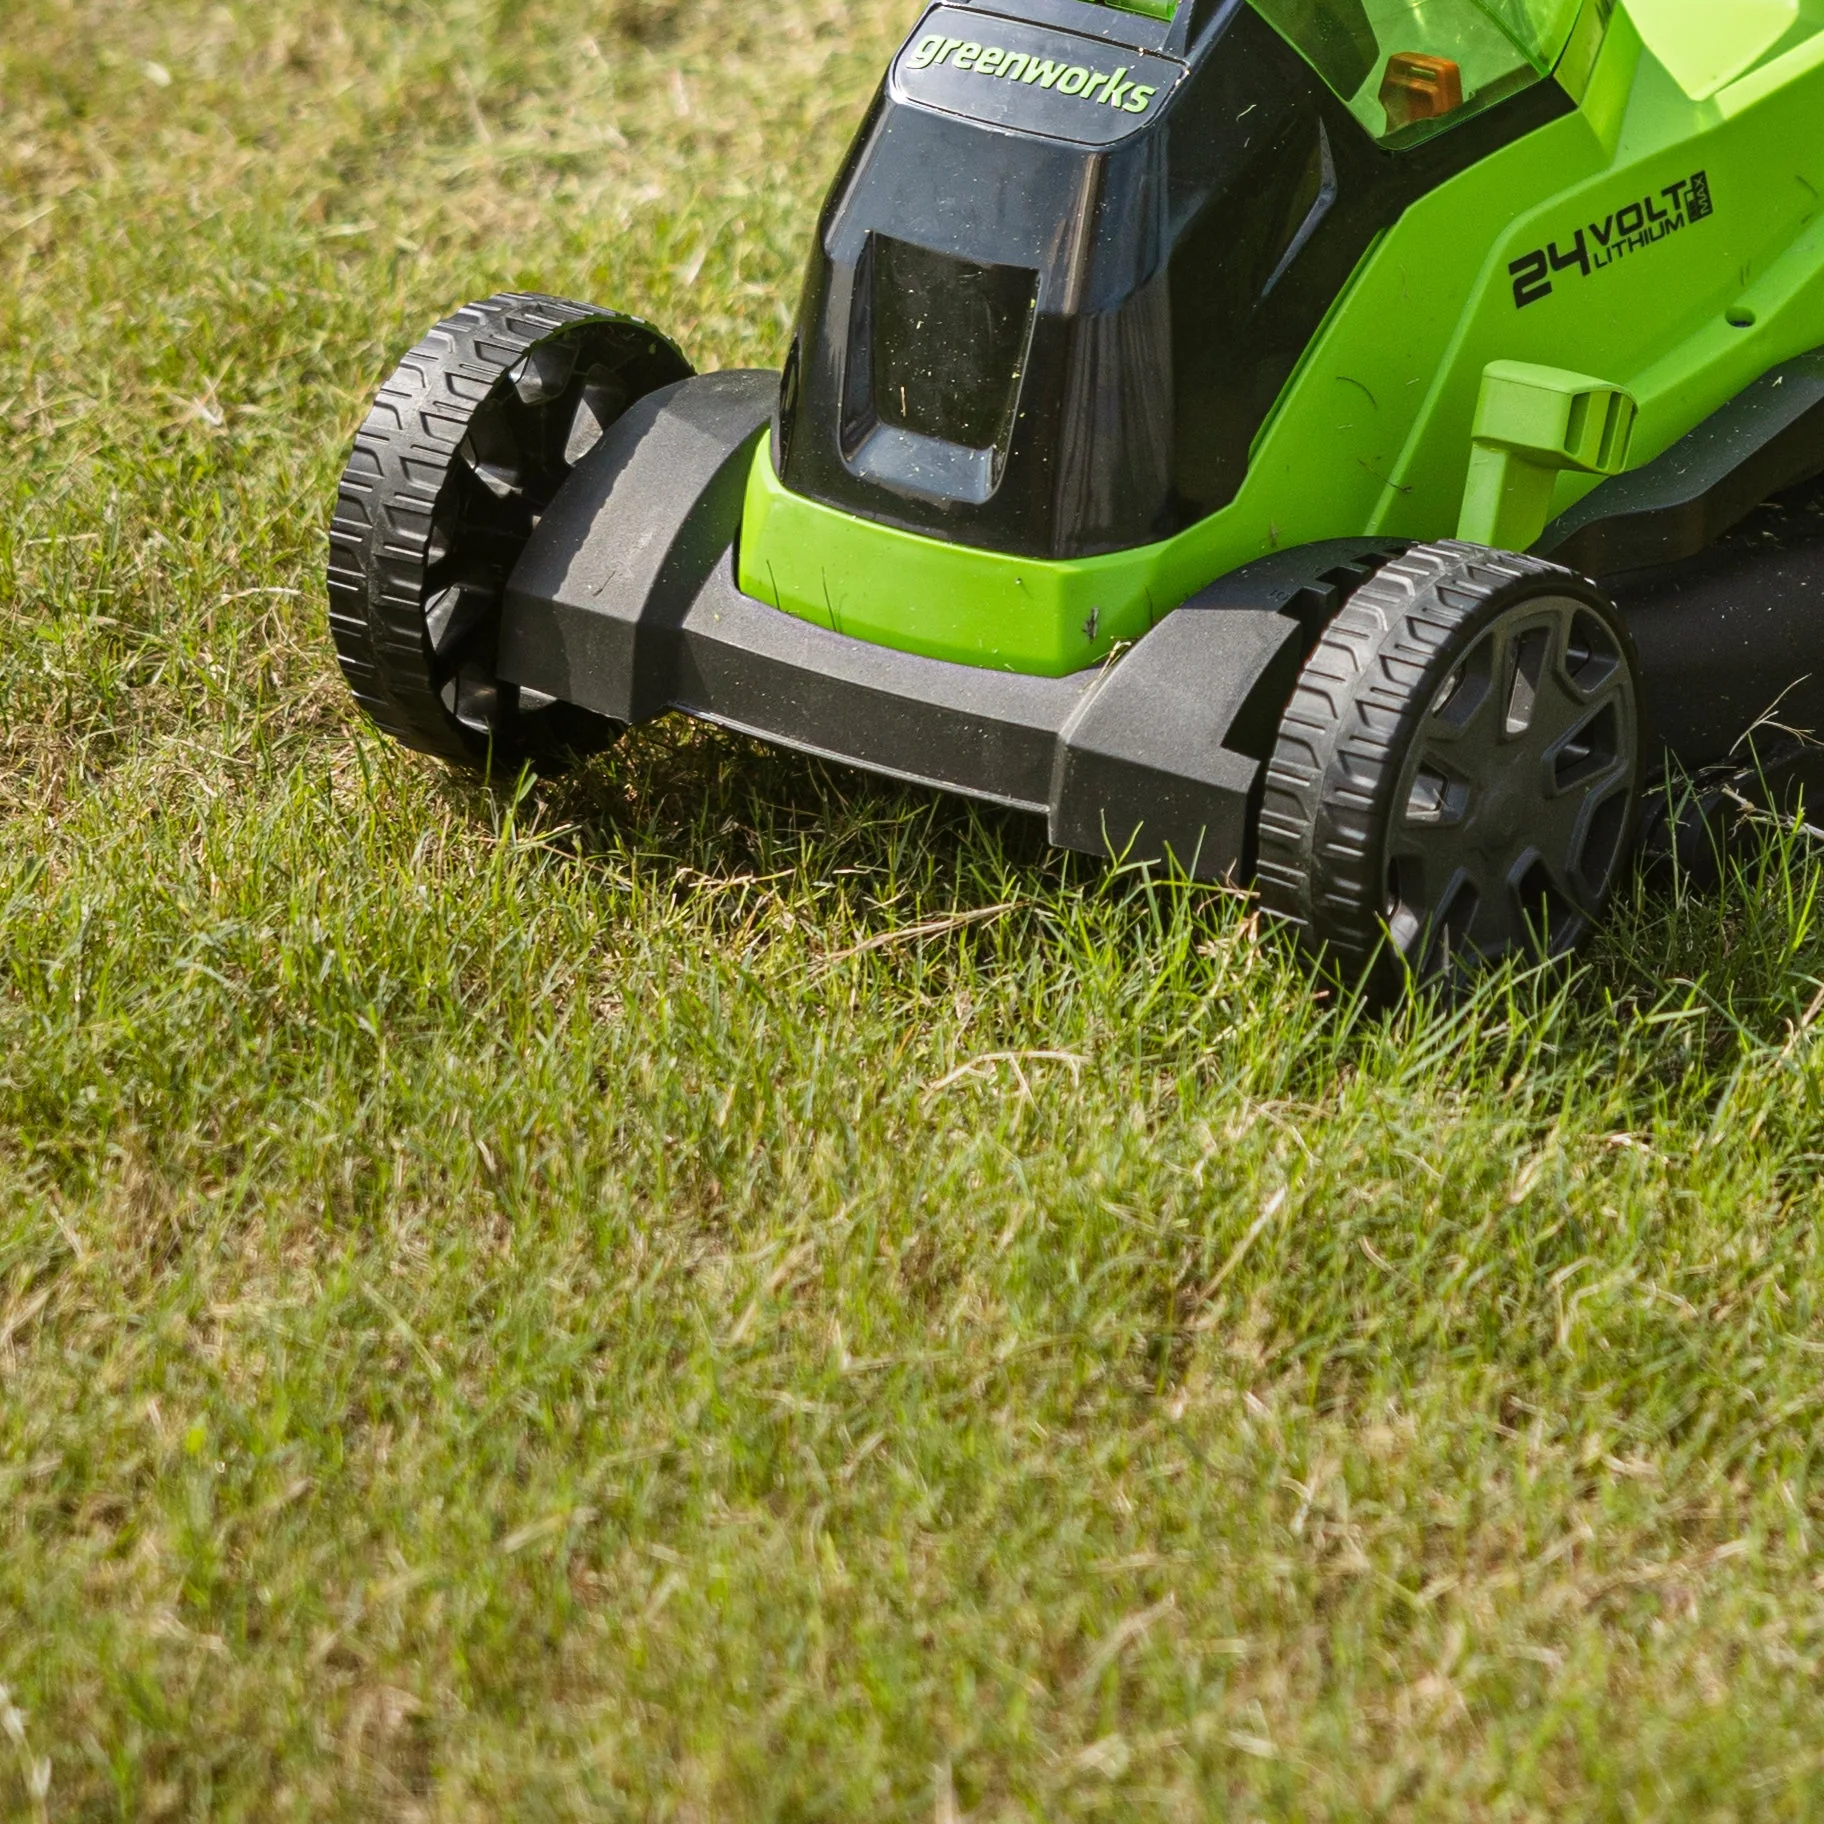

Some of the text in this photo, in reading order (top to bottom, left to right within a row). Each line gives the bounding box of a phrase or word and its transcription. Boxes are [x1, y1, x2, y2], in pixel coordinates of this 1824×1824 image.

[905, 33, 1156, 114] greenworks
[1507, 179, 1687, 310] 24 VOLT
[1593, 211, 1686, 269] LITHIUM
